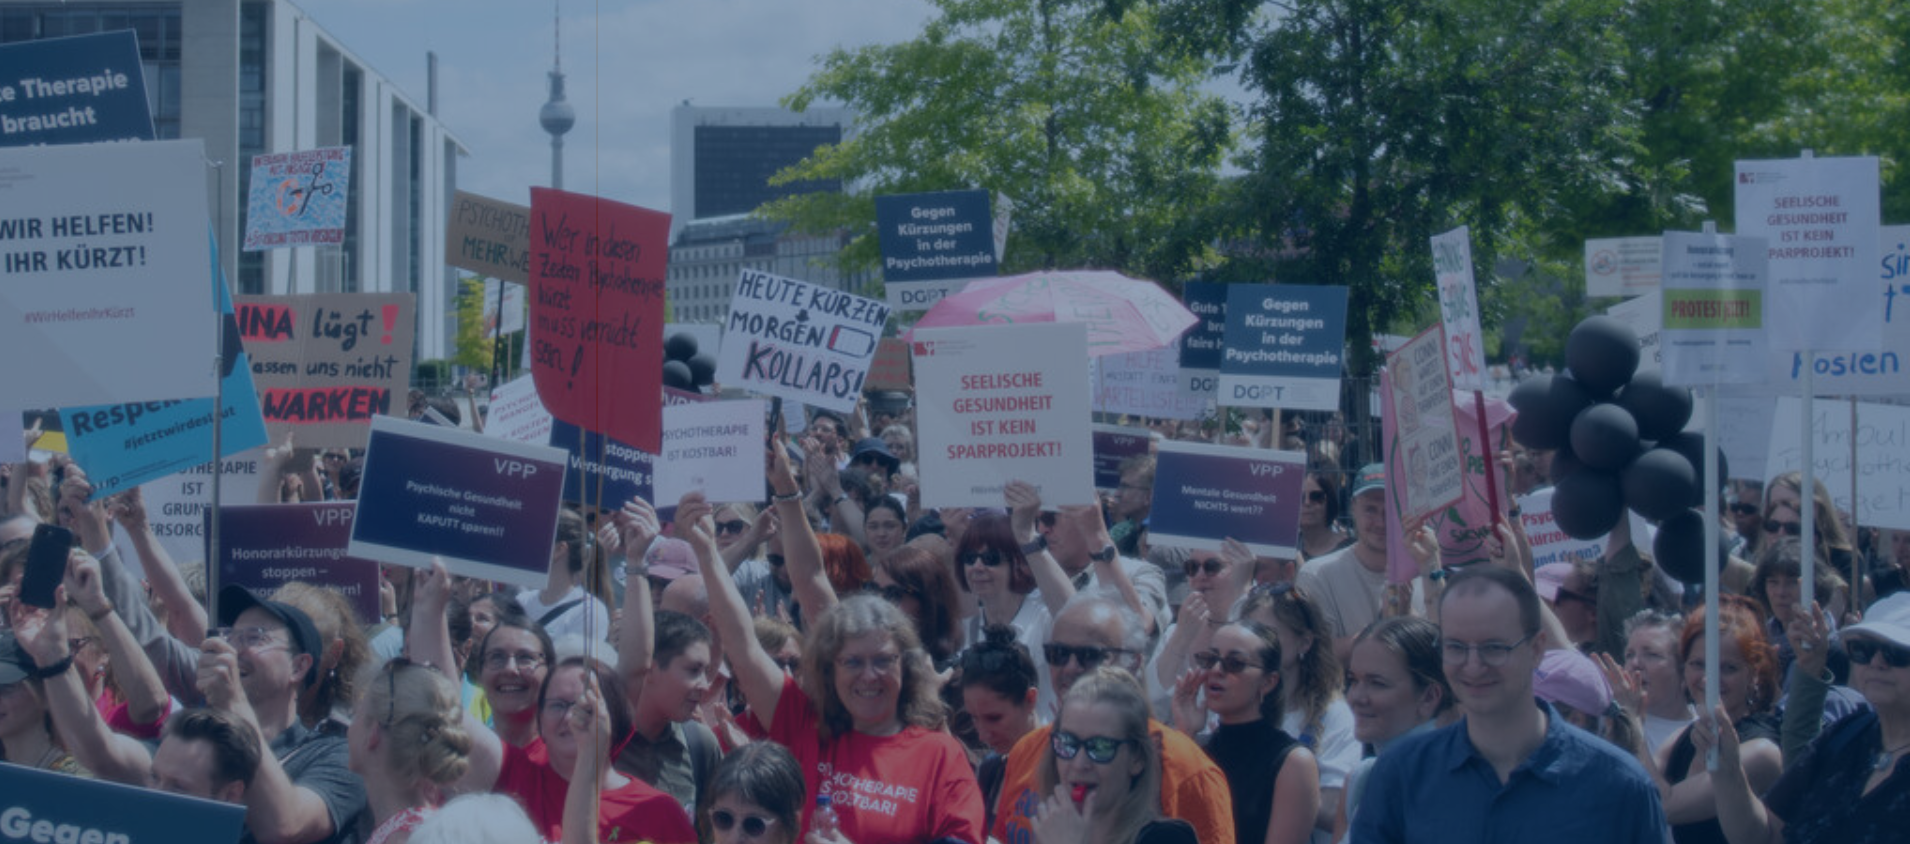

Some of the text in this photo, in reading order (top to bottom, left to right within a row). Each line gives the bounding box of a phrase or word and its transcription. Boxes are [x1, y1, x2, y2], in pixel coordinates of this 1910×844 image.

[20, 68, 129, 98] Therapie
[1, 106, 97, 134] braucht
[1774, 195, 1840, 209] SEELISCHE
[911, 207, 956, 220] Gegen
[1767, 212, 1848, 226] GESUNDHEIT
[0, 212, 153, 240] WIR HELFEN!
[541, 212, 578, 253] Wer
[898, 222, 973, 235] Kürzungen
[916, 238, 957, 250] in der
[1781, 230, 1834, 242] IST KEIN
[6, 243, 146, 273] IHR KÜRZT!
[886, 251, 993, 271] Psychotherapie
[1767, 246, 1855, 260] PARPROJEKT!
[739, 270, 891, 328] HEUTE KÜRZEN
[1191, 301, 1218, 314] Gute
[1262, 299, 1309, 313] Gegen
[24, 307, 136, 323] #WirHelfenIhrKürzt
[1671, 300, 1721, 318] PROTEST
[233, 305, 293, 340] INA
[538, 308, 642, 347] muss verrückt
[730, 309, 826, 348] MORGEN
[1245, 314, 1324, 330] Kürzungen
[1187, 336, 1216, 350] faire
[1262, 331, 1304, 345] in der
[1225, 348, 1339, 367] Psychotherapie
[306, 364, 339, 377] uns
[345, 355, 398, 379] nicht
[742, 340, 865, 401] KOLLAPS!
[961, 372, 1043, 390] SEELISCHE
[1234, 385, 1285, 400] DGPT
[263, 388, 391, 421] WARKEN
[953, 395, 1053, 413] GESUNDHEIT
[71, 398, 194, 437] Respe
[125, 406, 235, 451] #jetztwirdeslut
[971, 419, 1036, 436] IST KEIN
[1113, 436, 1136, 446] VPP
[682, 446, 737, 459] KOSTBAR!
[947, 442, 1062, 460] SPARPROJEKT!
[494, 458, 537, 478] VPP
[1250, 463, 1284, 477] VPP
[182, 482, 204, 495] IST
[406, 480, 522, 510] Psychische Gesundheit
[1181, 485, 1277, 504] Mentale Gesundheit
[162, 502, 211, 516] GRUN
[449, 505, 475, 517] nicht
[1194, 500, 1263, 516] NICHTS wert??
[313, 508, 354, 526] VPP
[417, 513, 460, 528] KAPUTT
[231, 546, 349, 561] Honorarkürzunge
[261, 566, 316, 579] stoppen
[0, 806, 130, 844] Gegen
